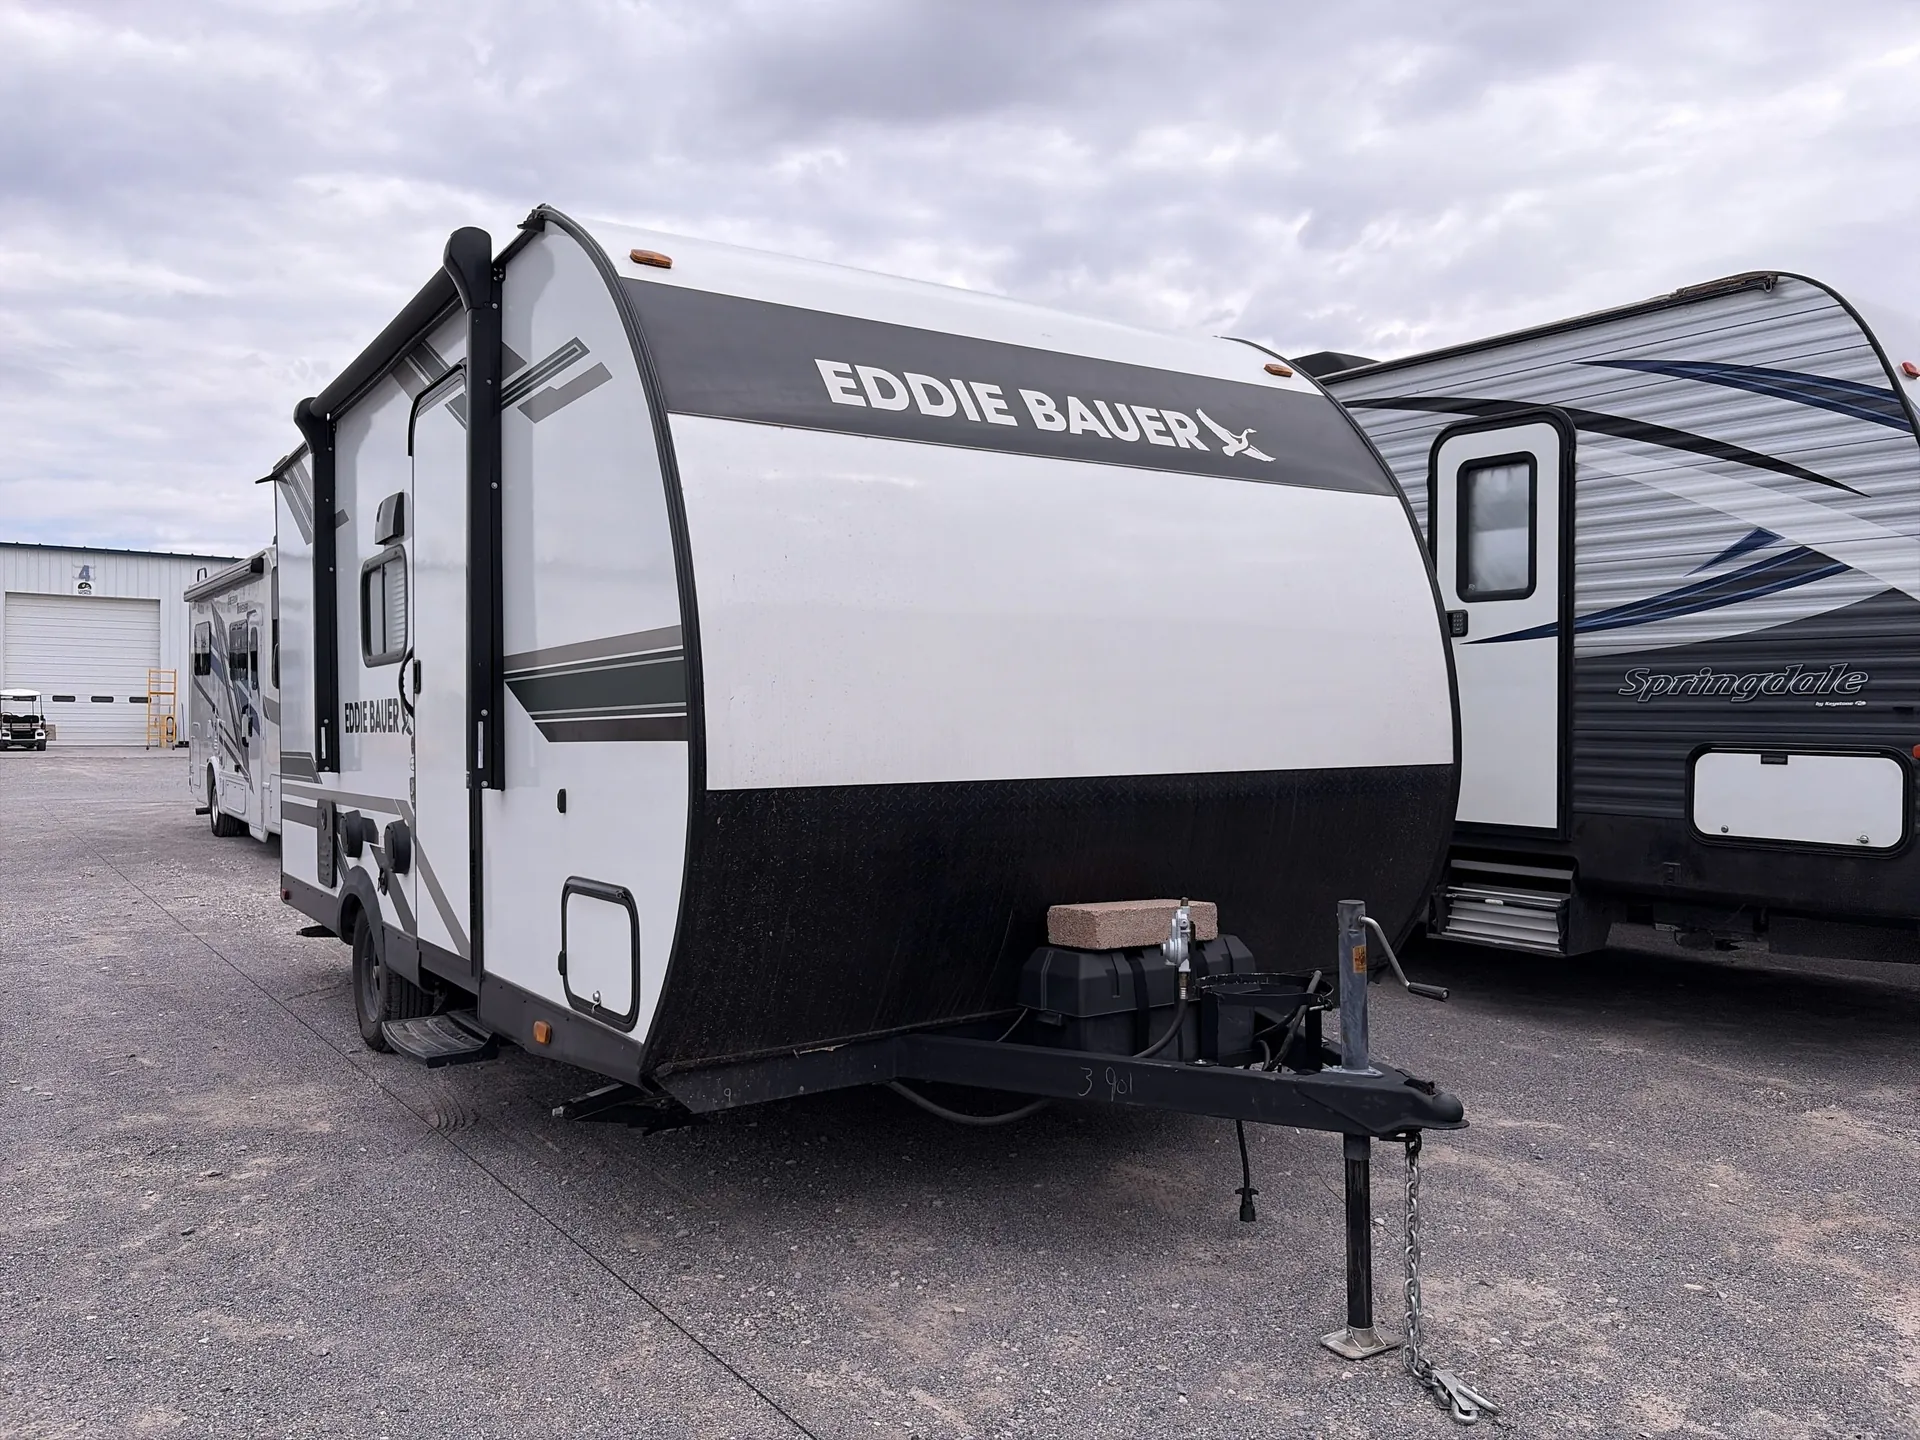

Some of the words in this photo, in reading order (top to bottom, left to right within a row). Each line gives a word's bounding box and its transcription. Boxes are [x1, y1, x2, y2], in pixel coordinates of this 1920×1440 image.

[814, 358, 1018, 427] EDDIE
[1018, 388, 1210, 452] BAUER
[78, 564, 90, 581] 4
[1618, 662, 1869, 702] Springdale
[344, 700, 368, 733] EDDIE
[369, 698, 399, 733] BAUER
[1078, 1065, 1093, 1097] 3
